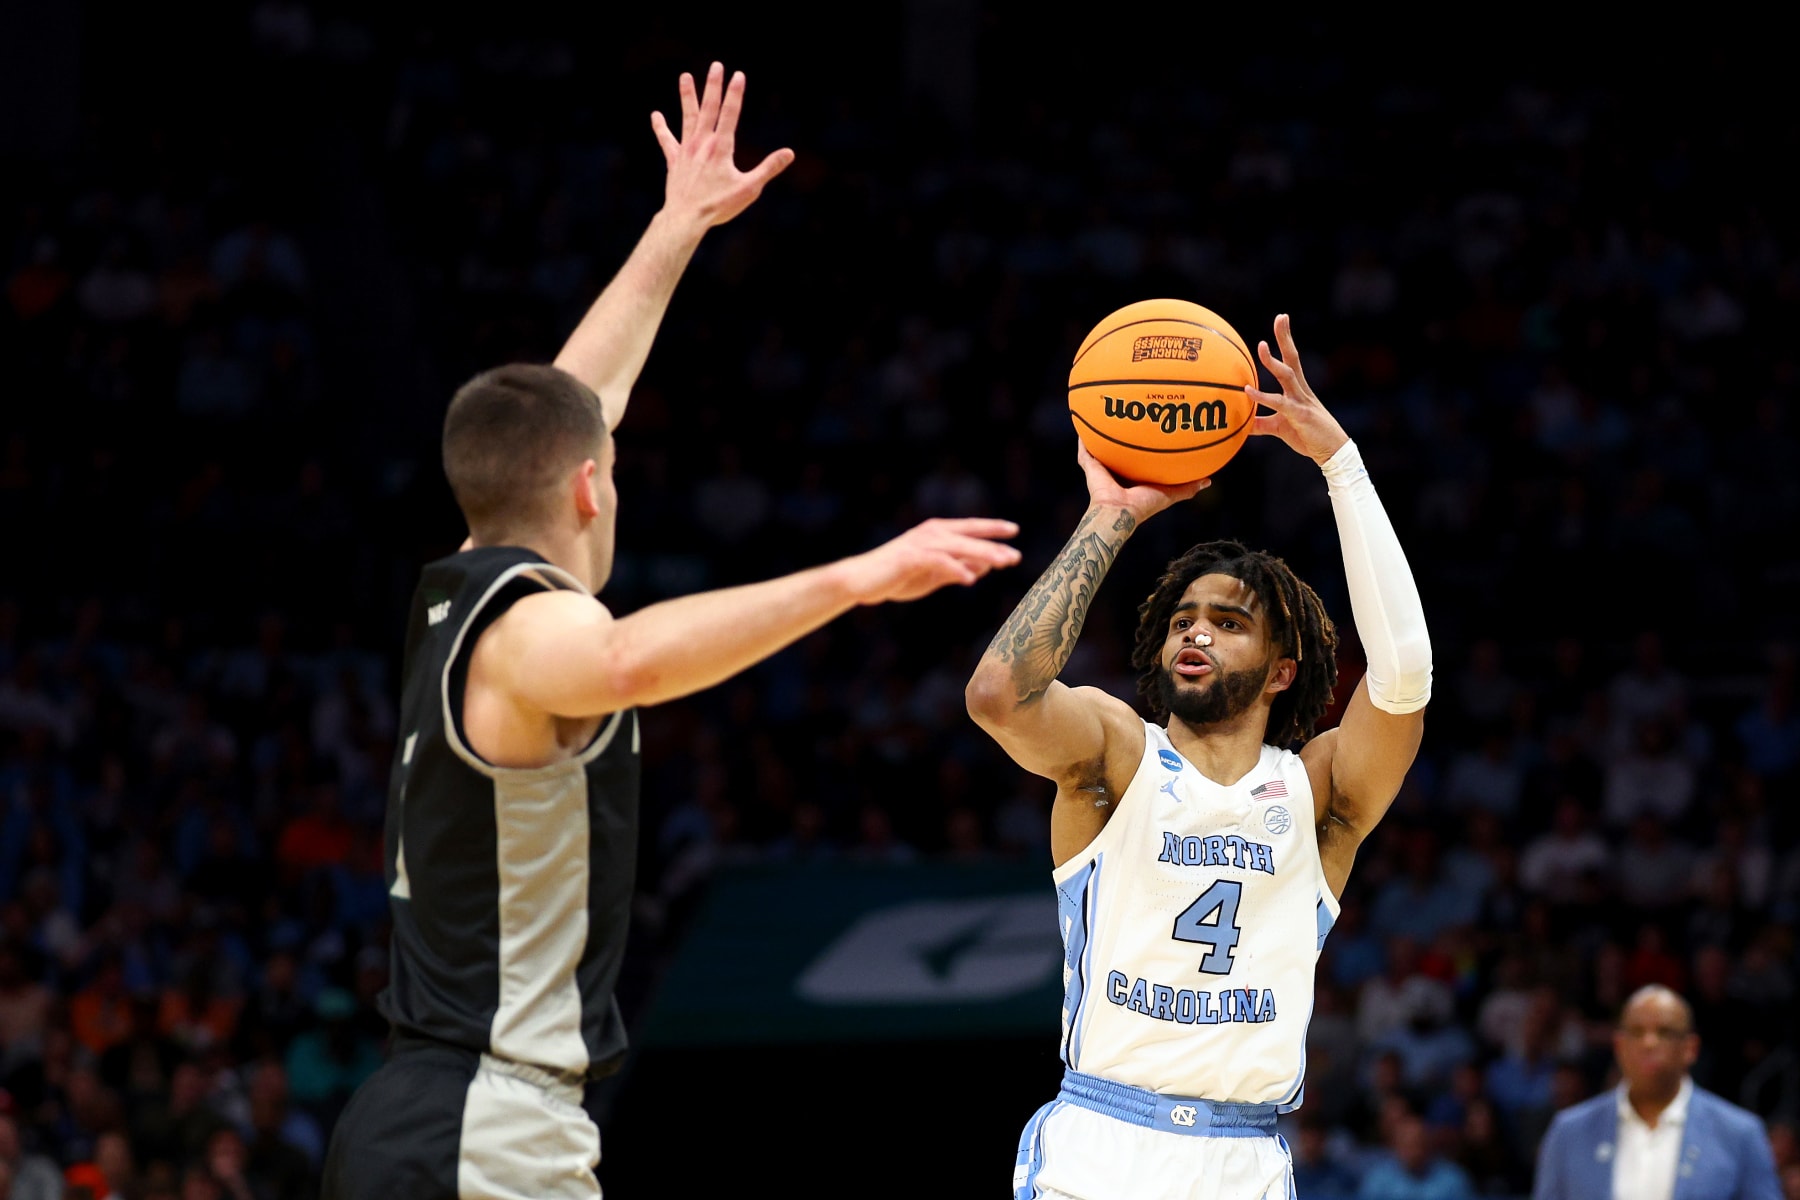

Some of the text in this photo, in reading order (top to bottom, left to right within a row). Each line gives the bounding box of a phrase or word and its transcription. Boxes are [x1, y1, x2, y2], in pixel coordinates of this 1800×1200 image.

[1134, 337, 1185, 350] MADNESS
[1150, 348, 1187, 360] MARCH
[1104, 396, 1228, 434] Wilson
[1063, 547, 1087, 574] hungry
[1161, 755, 1182, 769] NCAA
[1158, 832, 1275, 876] NORTH
[1172, 879, 1242, 975] 4
[1107, 970, 1277, 1025] CAROLINA
